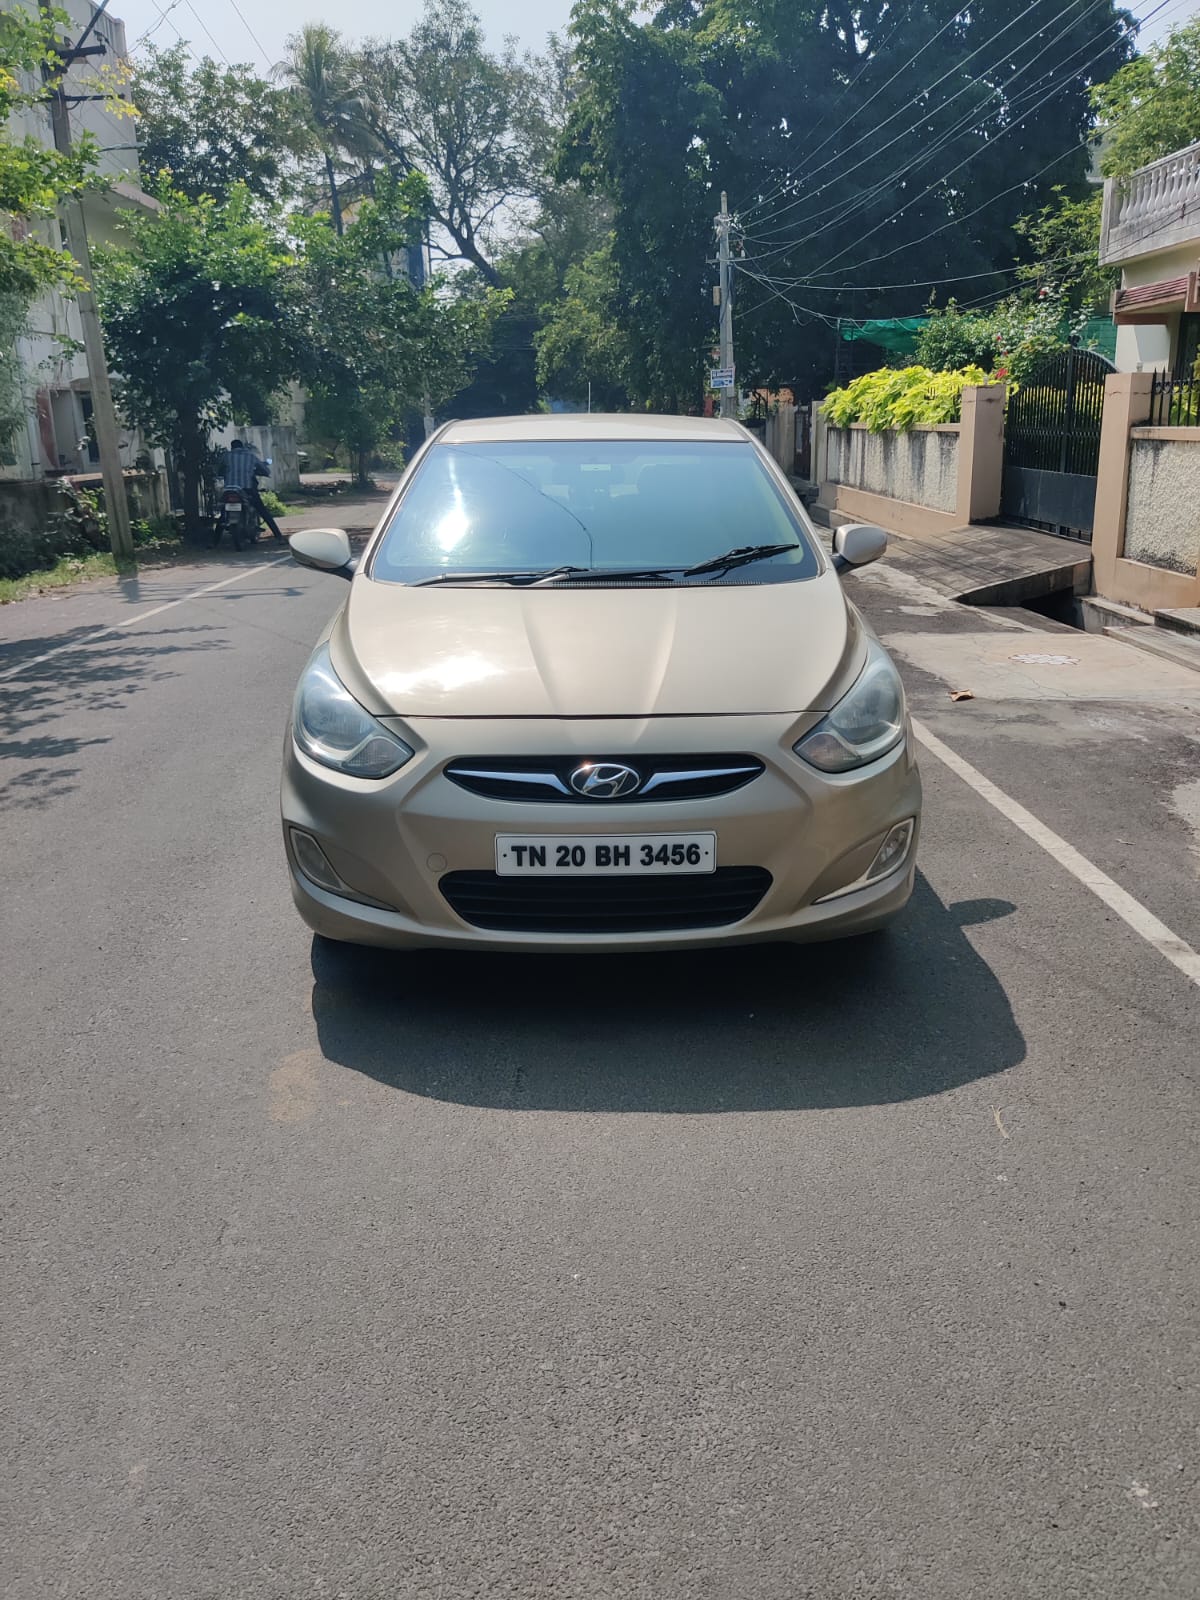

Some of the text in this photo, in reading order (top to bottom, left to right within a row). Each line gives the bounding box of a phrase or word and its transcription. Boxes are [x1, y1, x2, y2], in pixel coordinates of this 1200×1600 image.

[510, 842, 701, 868] TN 20 BH 3456
